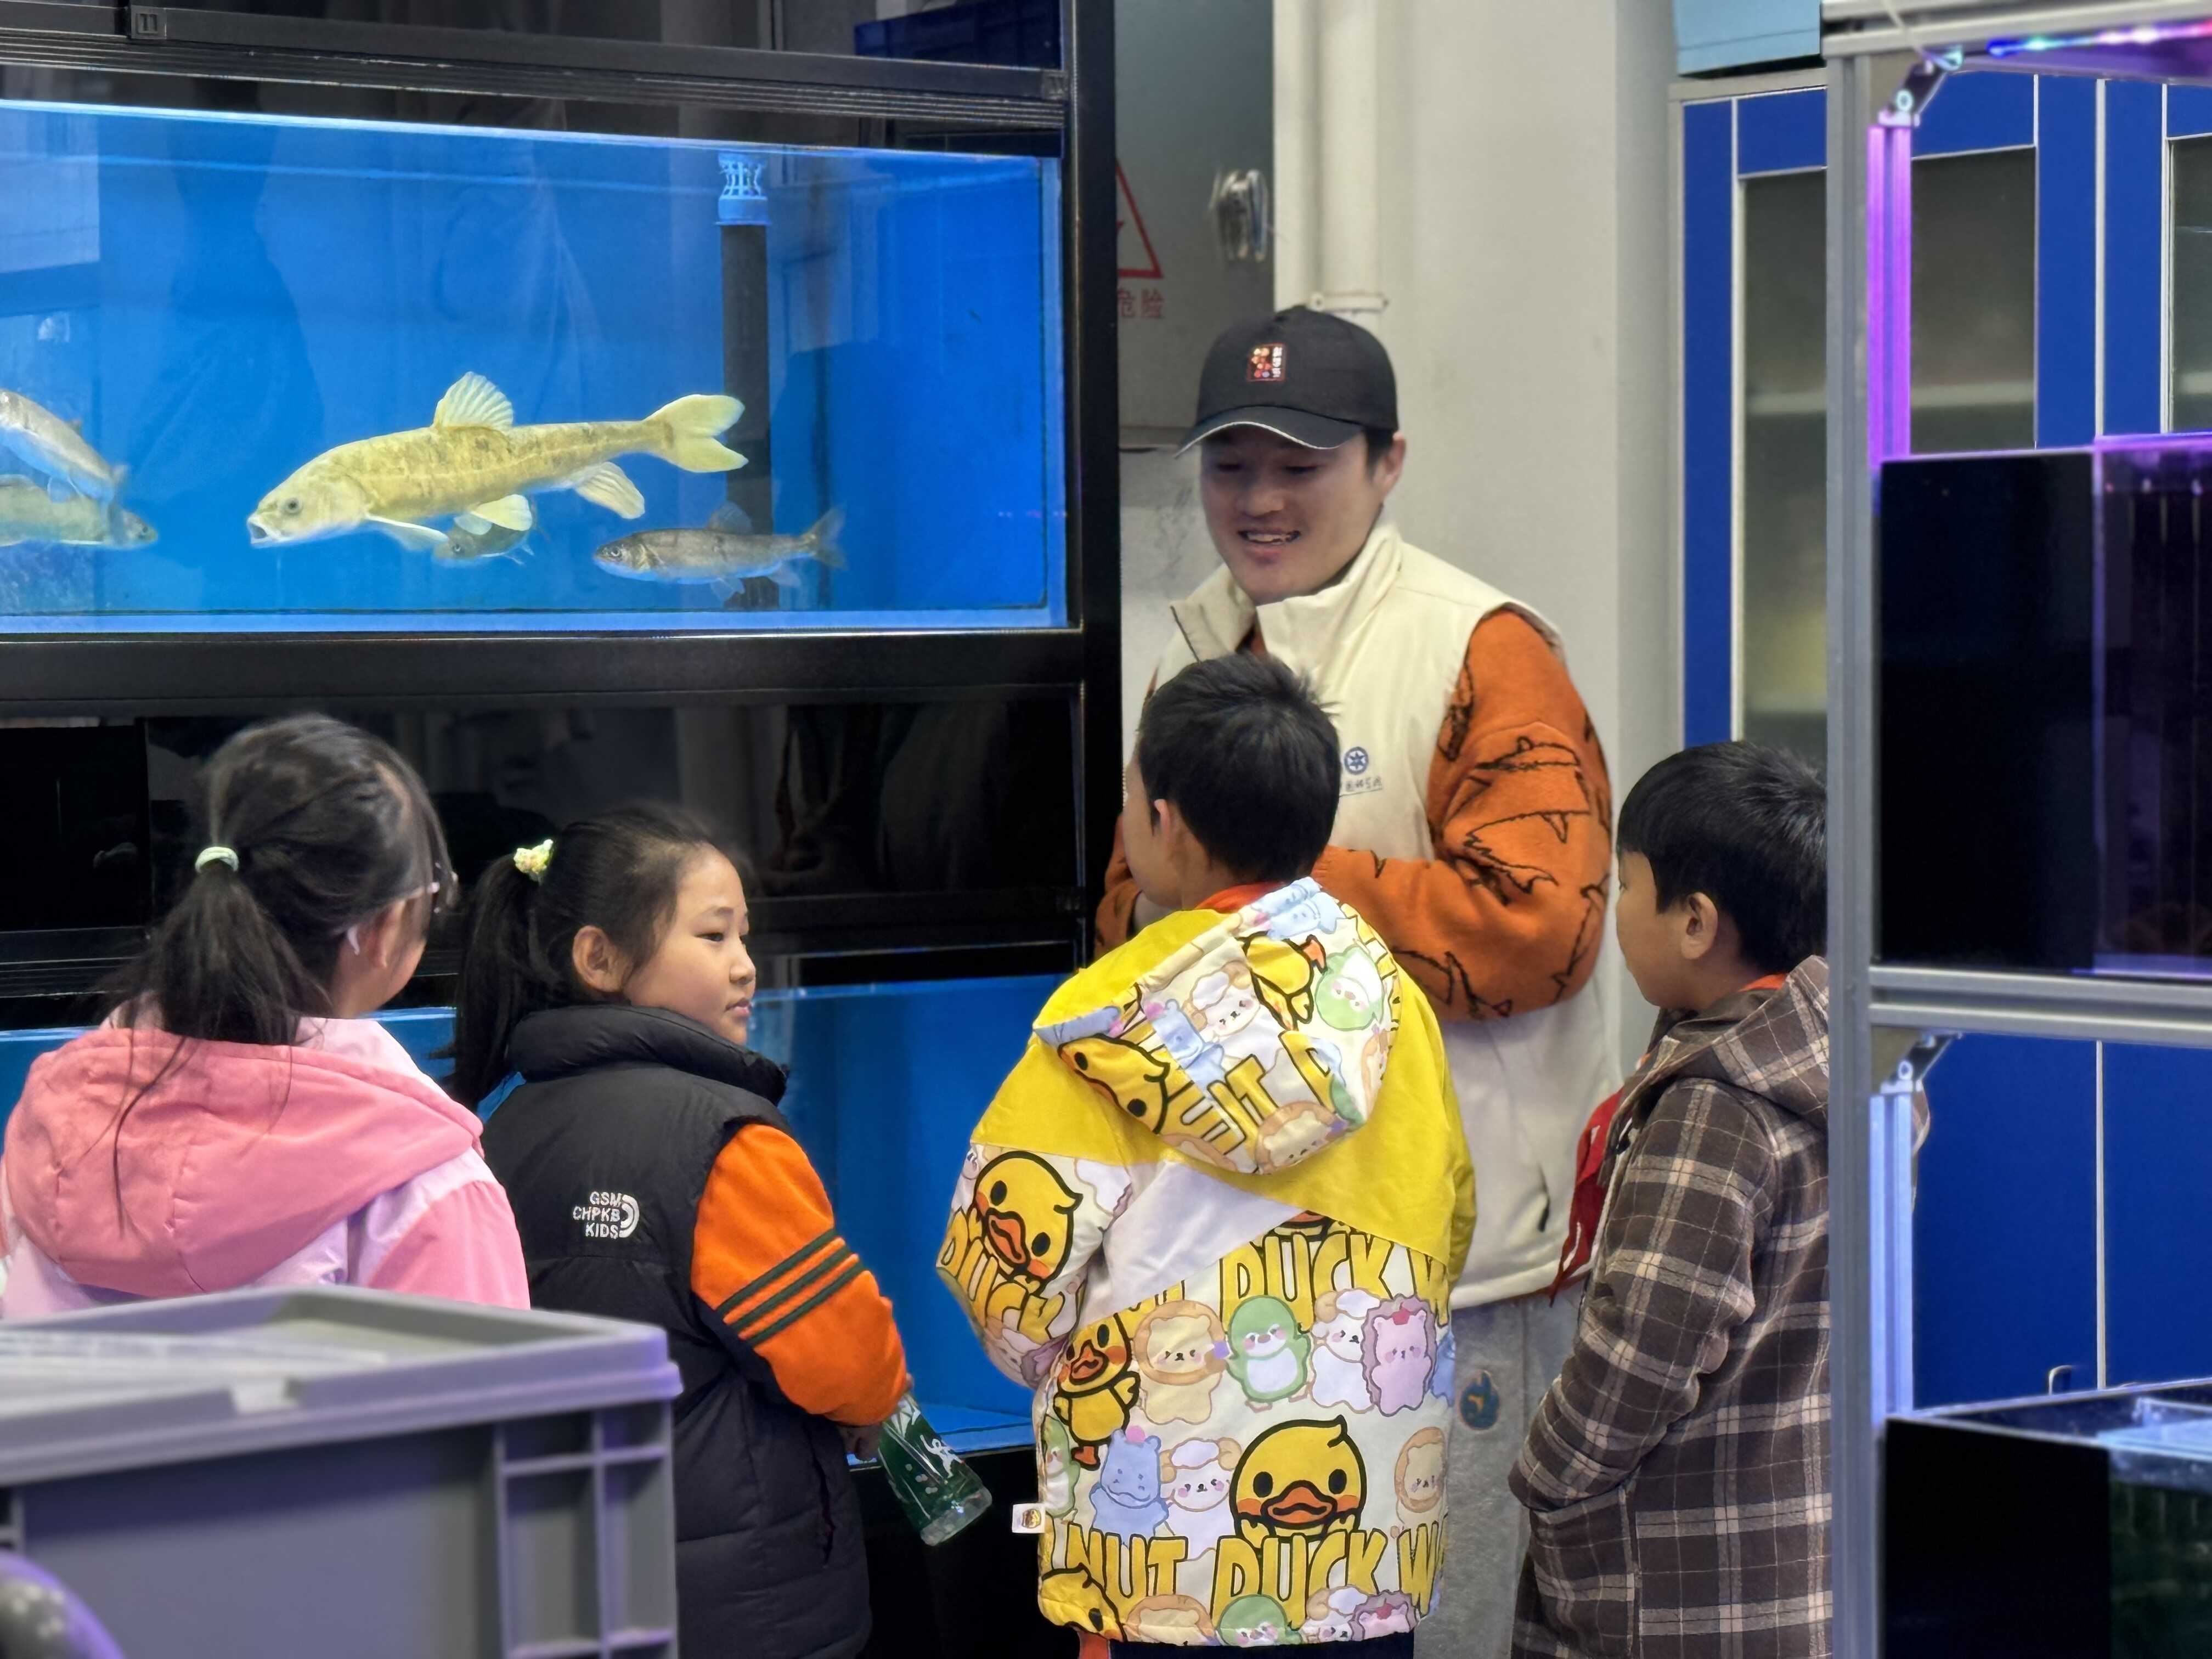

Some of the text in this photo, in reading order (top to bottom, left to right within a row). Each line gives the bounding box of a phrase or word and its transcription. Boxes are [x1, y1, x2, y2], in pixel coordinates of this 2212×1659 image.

[585, 1222, 619, 1239] KIDS
[1218, 1231, 1395, 1333] DUCK
[1209, 1528, 1388, 1630] DUCK
